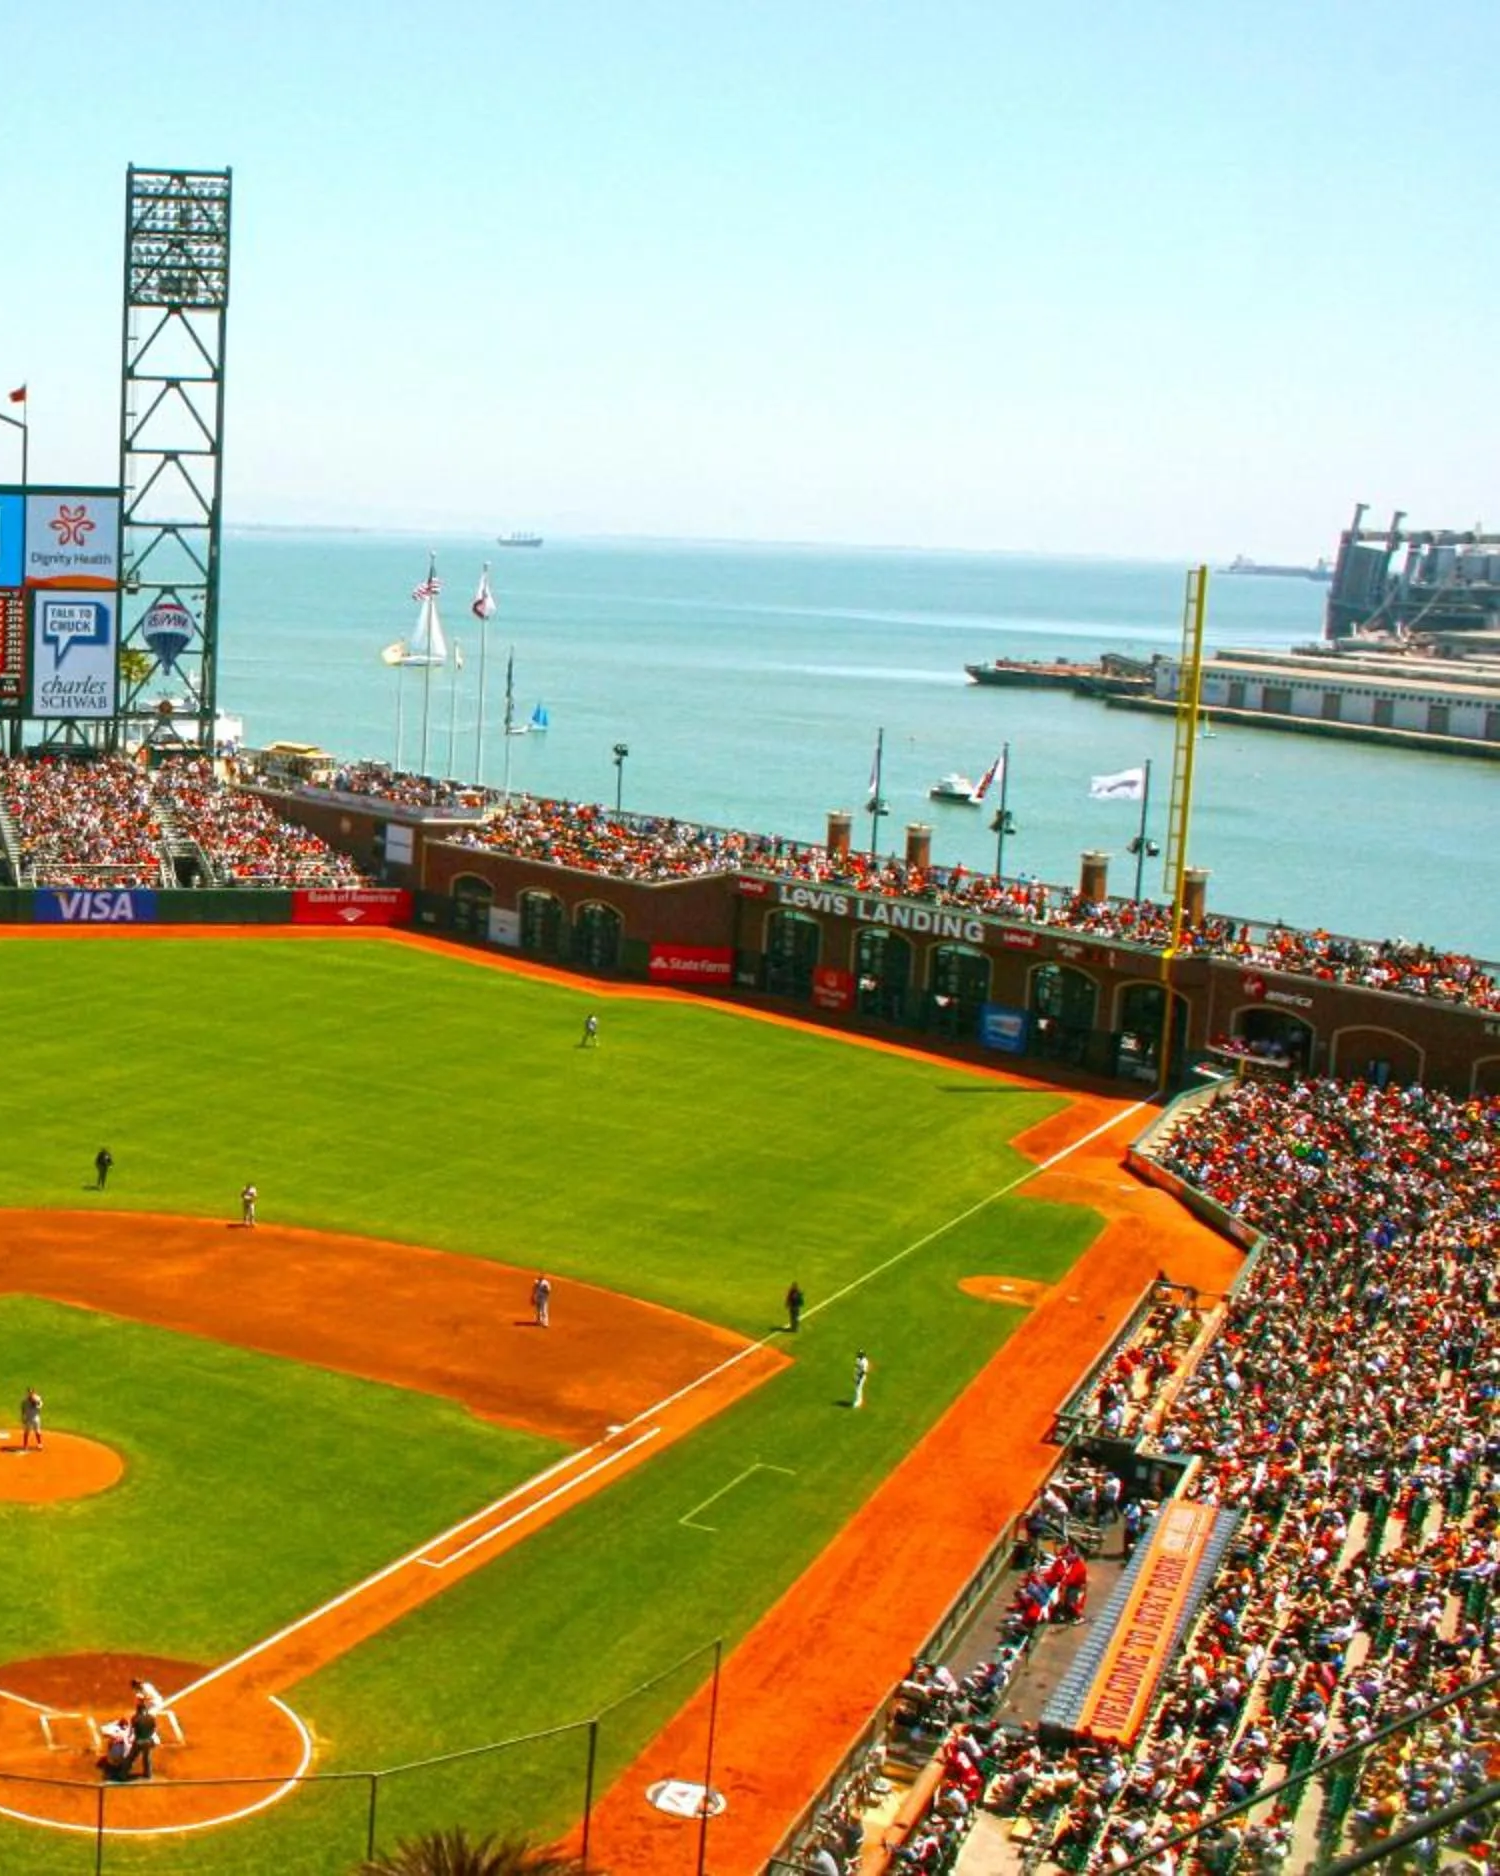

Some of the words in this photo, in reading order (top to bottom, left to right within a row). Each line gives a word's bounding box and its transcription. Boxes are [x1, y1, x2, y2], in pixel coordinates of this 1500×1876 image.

[31, 552, 72, 567] Dignity
[73, 552, 112, 565] Health
[49, 607, 75, 619] TALK
[78, 608, 92, 619] TO
[49, 620, 91, 632] CHUCK
[41, 675, 107, 694] charles
[40, 696, 107, 709] SCHWAB
[53, 891, 134, 921] VISA
[308, 891, 335, 902] Bank
[349, 892, 397, 903] America
[778, 885, 849, 916] Levi's
[856, 900, 985, 943] LANDING
[1148, 1555, 1188, 1591] PARK
[1133, 1589, 1174, 1627] AT&T
[1123, 1627, 1158, 1653] TO
[1090, 1651, 1148, 1730] WELCOME
